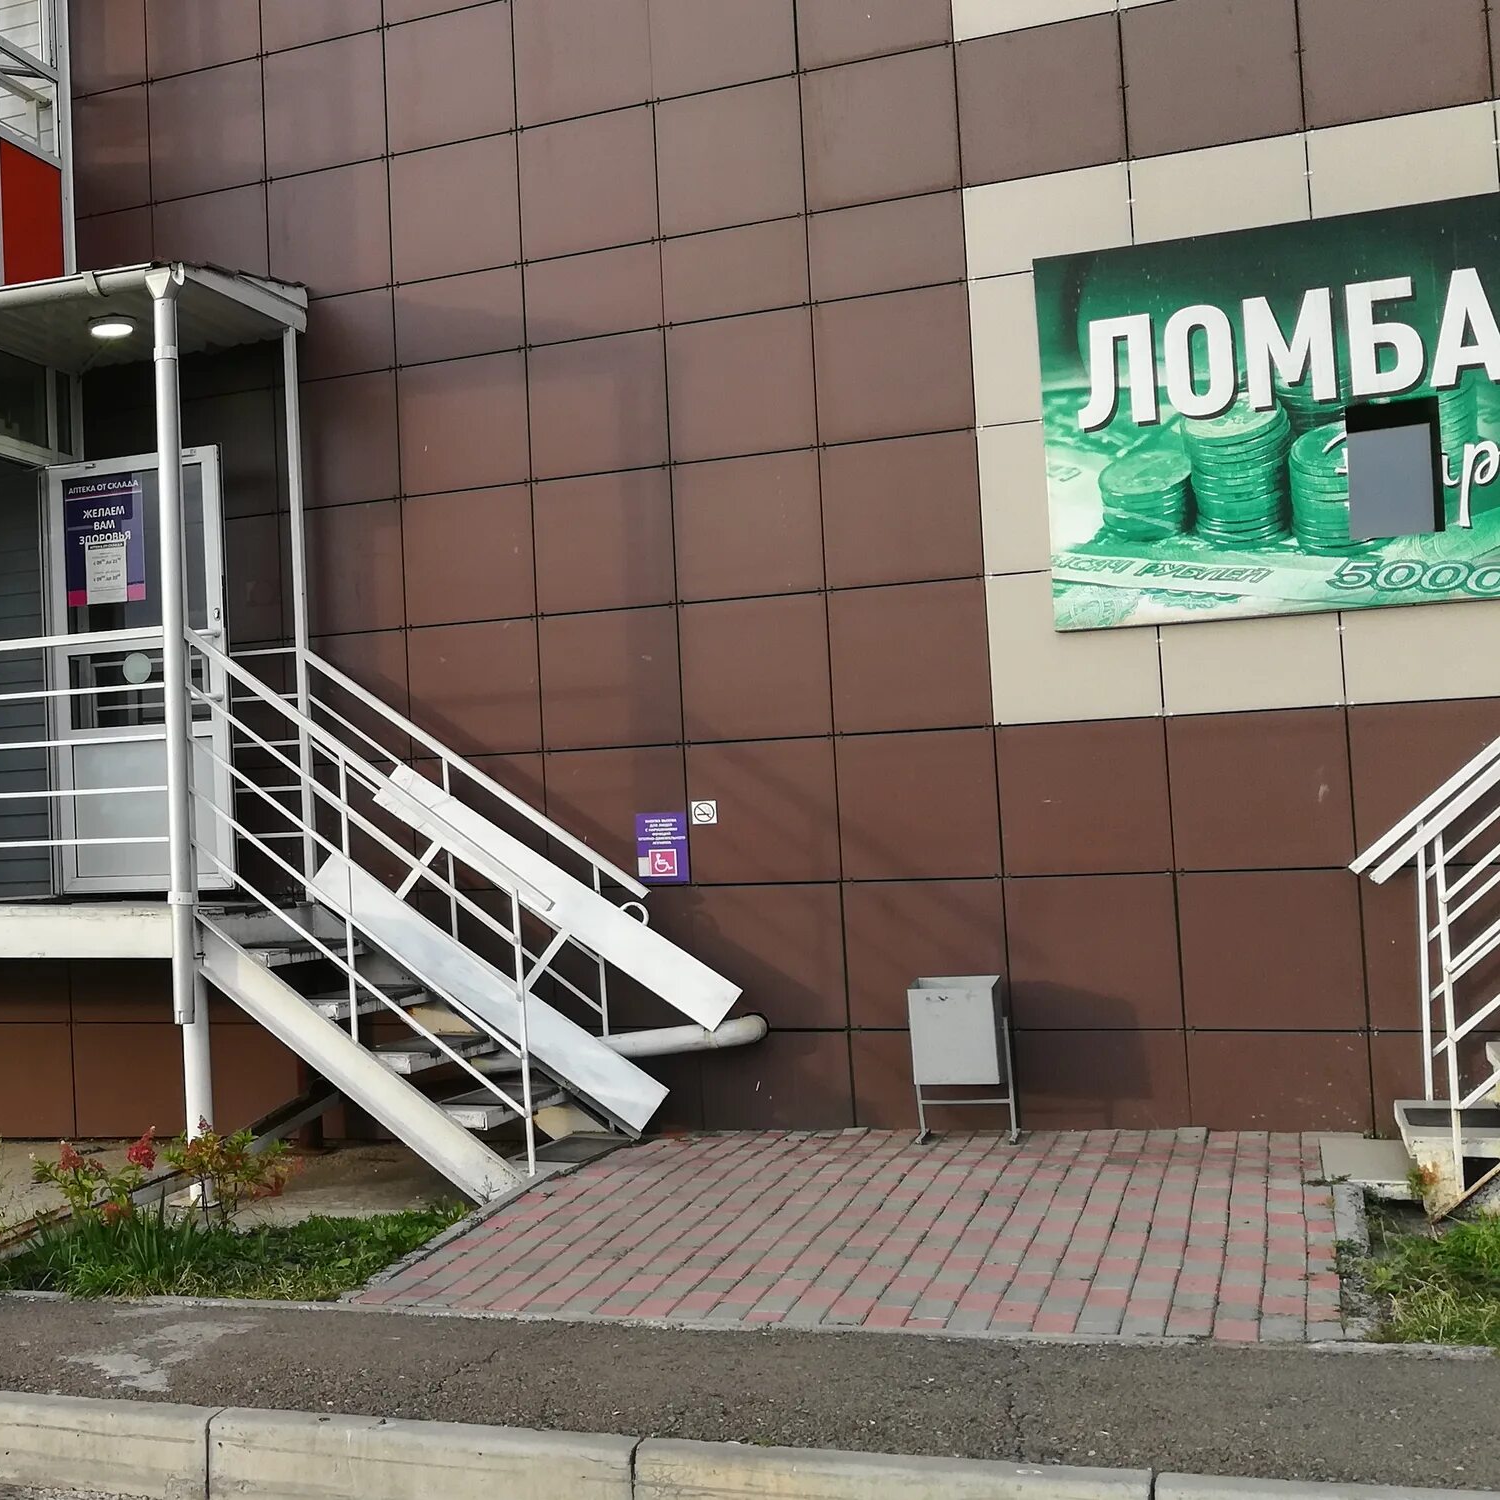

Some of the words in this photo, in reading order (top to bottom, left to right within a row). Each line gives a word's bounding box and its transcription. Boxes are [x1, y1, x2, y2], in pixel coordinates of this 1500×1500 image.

[68, 485, 96, 495] АПТЕКА
[97, 483, 106, 491] ОТ
[107, 480, 139, 490] СКЛАДА
[83, 506, 125, 519] ЖЕЛАЕМ
[94, 520, 116, 531] ВАМ
